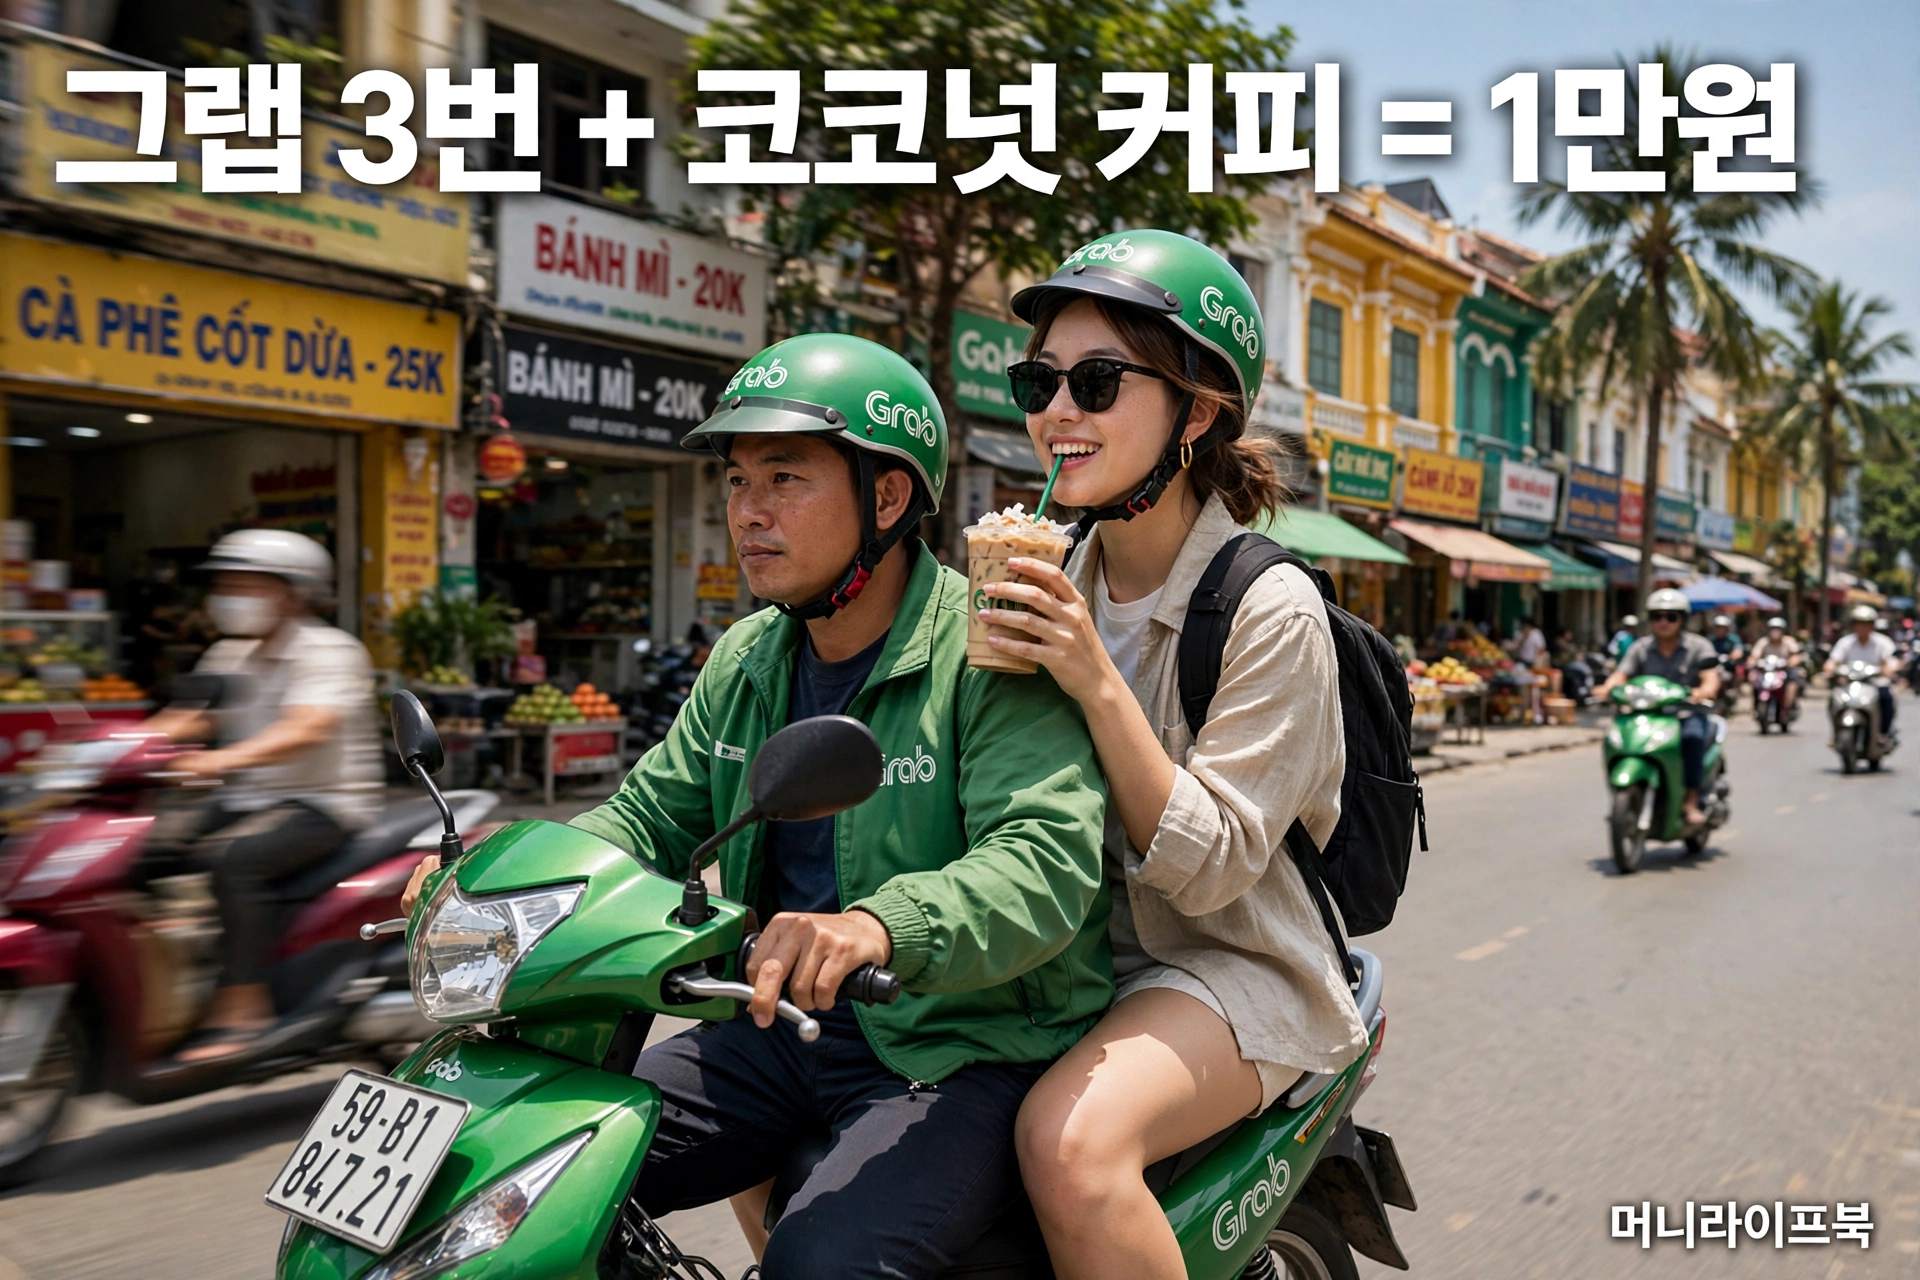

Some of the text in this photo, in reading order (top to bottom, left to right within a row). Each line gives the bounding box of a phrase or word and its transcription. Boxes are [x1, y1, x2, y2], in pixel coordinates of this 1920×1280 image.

[535, 215, 626, 290] BÁNH
[635, 239, 672, 300] MÌ
[692, 262, 747, 317] 20K
[18, 273, 82, 345] CÀ
[97, 293, 182, 358] PHÊ
[194, 300, 272, 370] CỐT
[283, 317, 356, 384] DỪA
[385, 345, 446, 396] 25K
[1200, 285, 1259, 360] Grab
[507, 342, 594, 404] BÁNH
[600, 357, 635, 411] MÌ
[653, 376, 708, 423] 20K
[724, 358, 788, 395] Grab
[865, 390, 937, 447] Grab
[331, 1082, 441, 1163] 59-B1
[281, 1140, 414, 1237] 847.21
[1212, 1152, 1291, 1251] Grab
